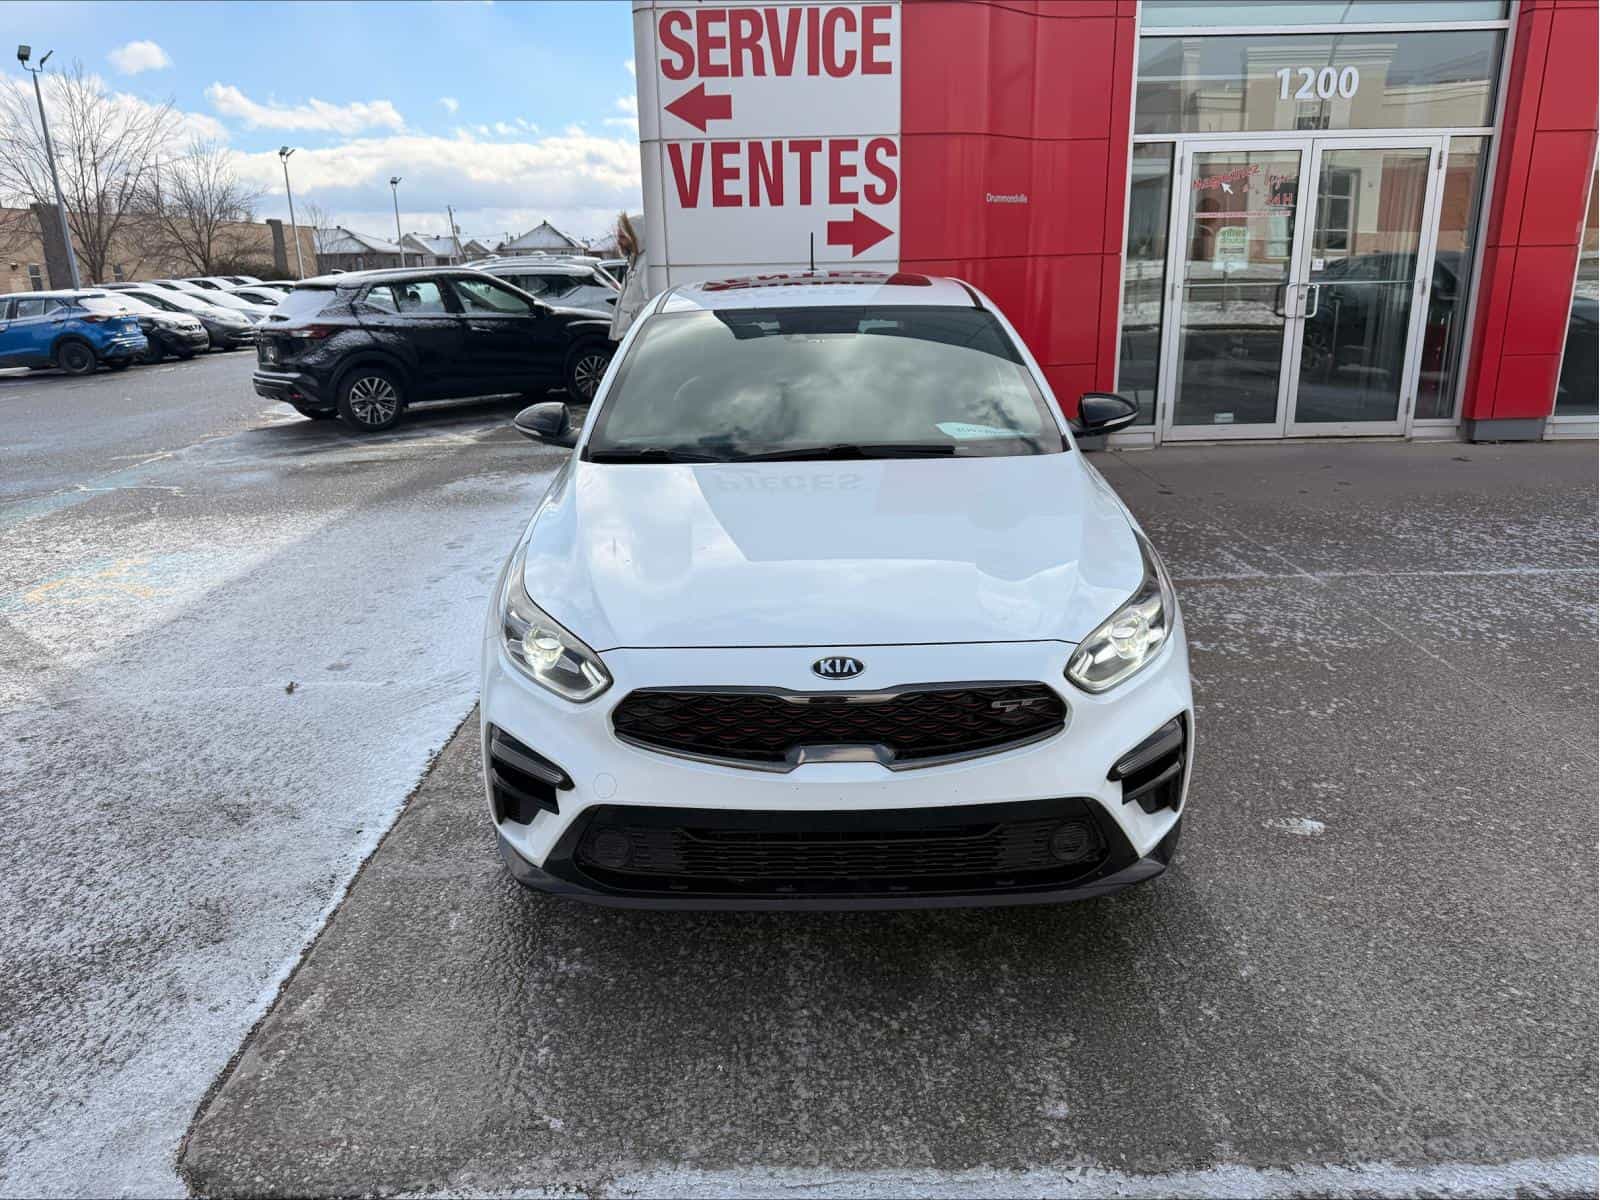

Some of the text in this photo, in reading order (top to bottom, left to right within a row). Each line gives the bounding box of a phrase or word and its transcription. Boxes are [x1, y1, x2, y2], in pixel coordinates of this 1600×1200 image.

[659, 6, 892, 80] SERVICE
[1276, 65, 1360, 100] 1200
[667, 137, 898, 209] VENTES
[819, 658, 858, 674] KIA
